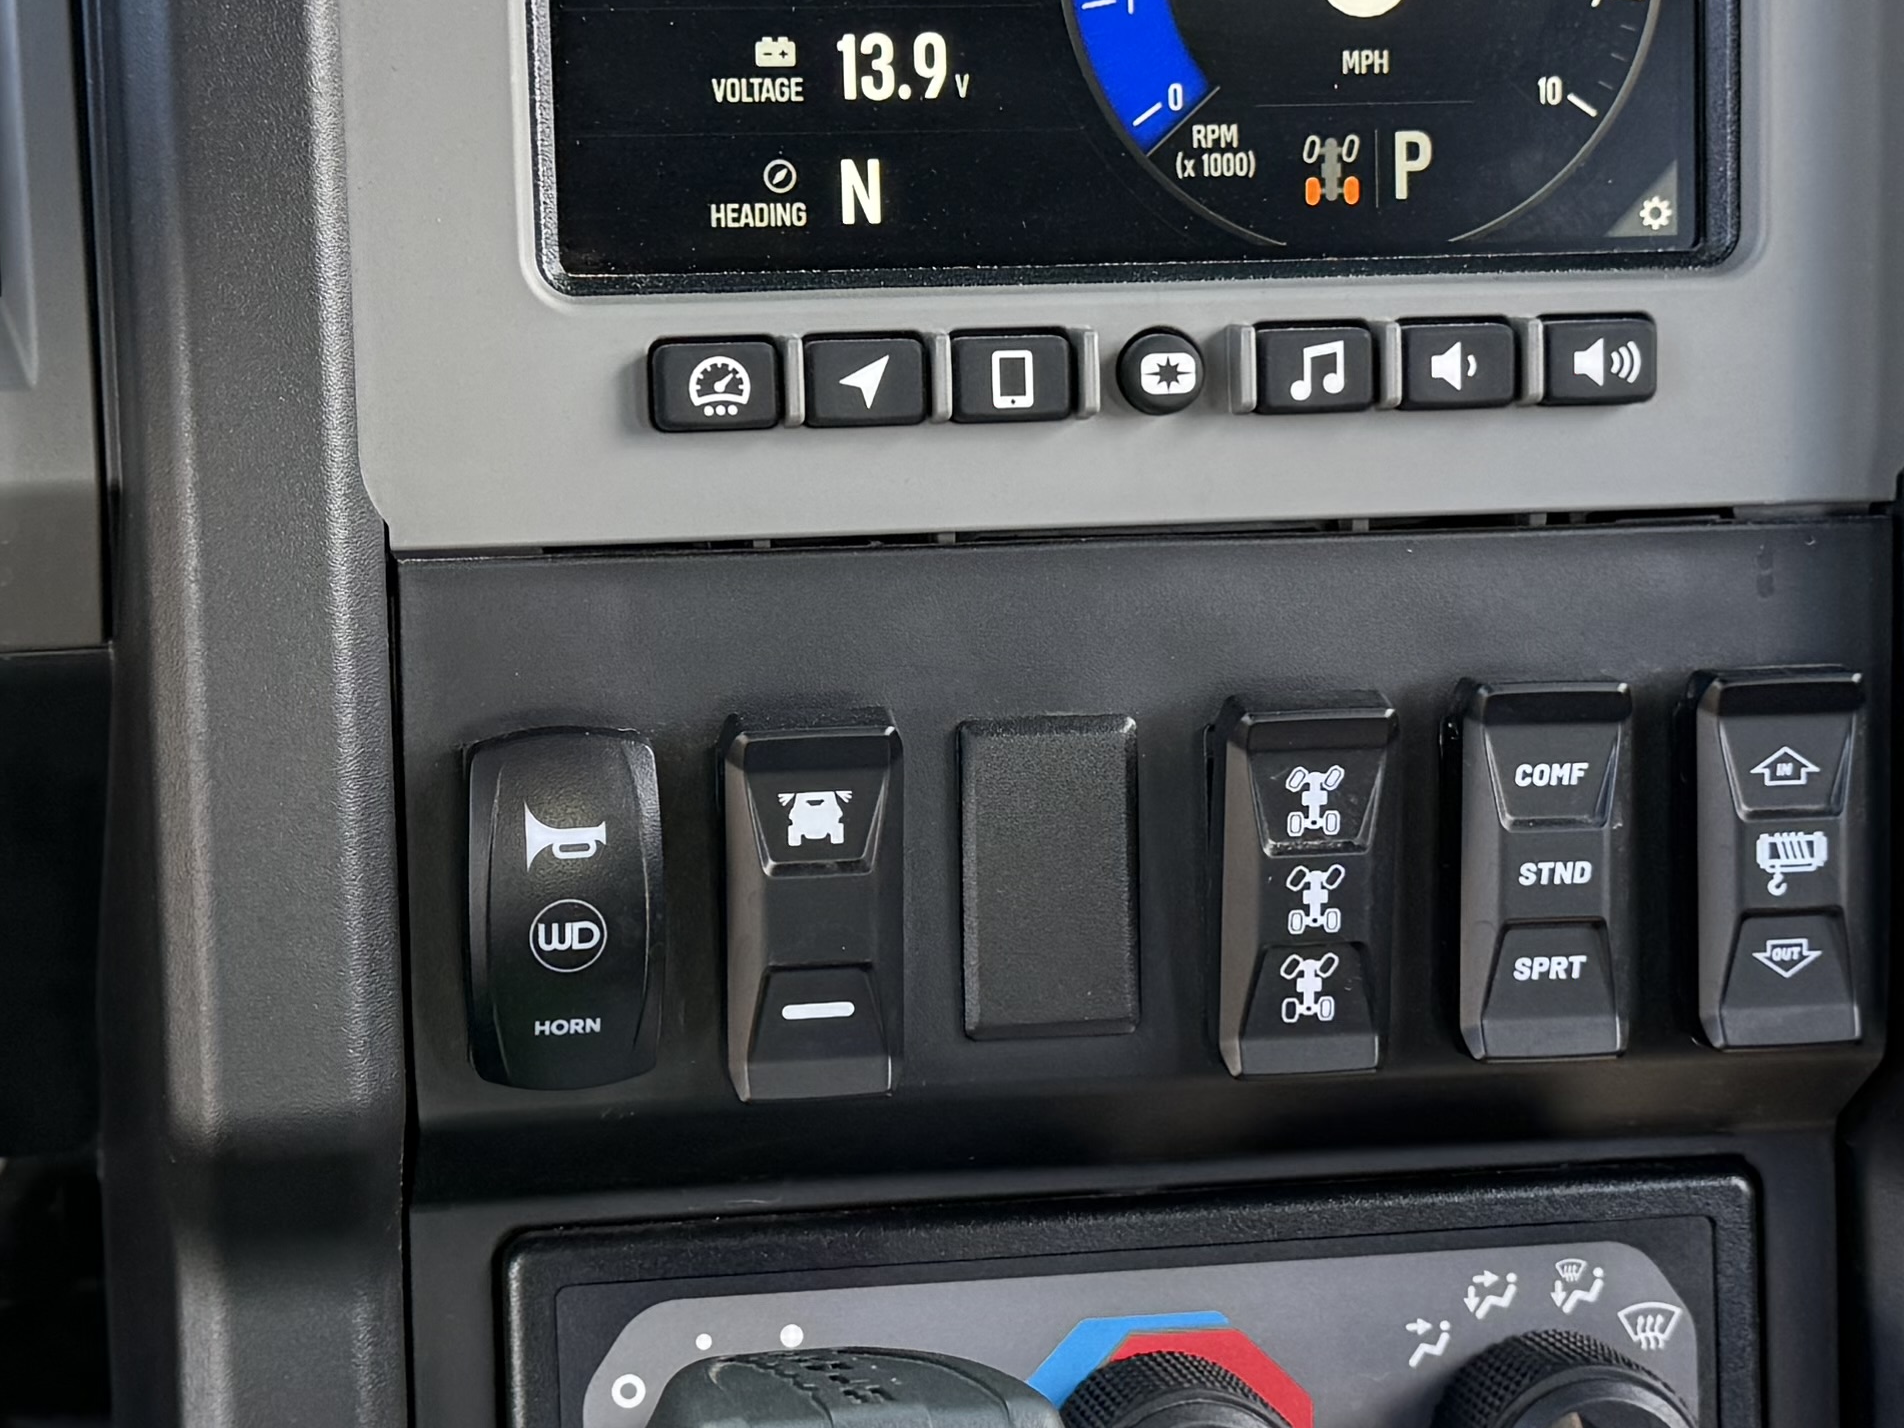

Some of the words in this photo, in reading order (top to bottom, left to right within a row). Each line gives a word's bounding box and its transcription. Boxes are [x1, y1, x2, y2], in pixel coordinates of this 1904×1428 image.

[836, 31, 947, 101] 13.9
[954, 73, 970, 99] V
[1342, 49, 1389, 75] MPH
[711, 77, 804, 103] VOLTAGE
[1167, 82, 1183, 111] 0
[1537, 75, 1563, 106] 10
[1192, 123, 1239, 149] RPM
[1175, 151, 1196, 180] (x
[1201, 149, 1257, 179] 1000)
[1394, 130, 1432, 200] P
[840, 158, 882, 225] N
[710, 201, 807, 228] HEADING
[1514, 762, 1589, 787] COMF
[1775, 762, 1794, 777] IN
[1518, 860, 1593, 886] STND
[537, 920, 601, 952] WD
[1513, 954, 1588, 981] SPRT
[1771, 946, 1802, 962] OUT
[534, 1017, 601, 1036] HORN
